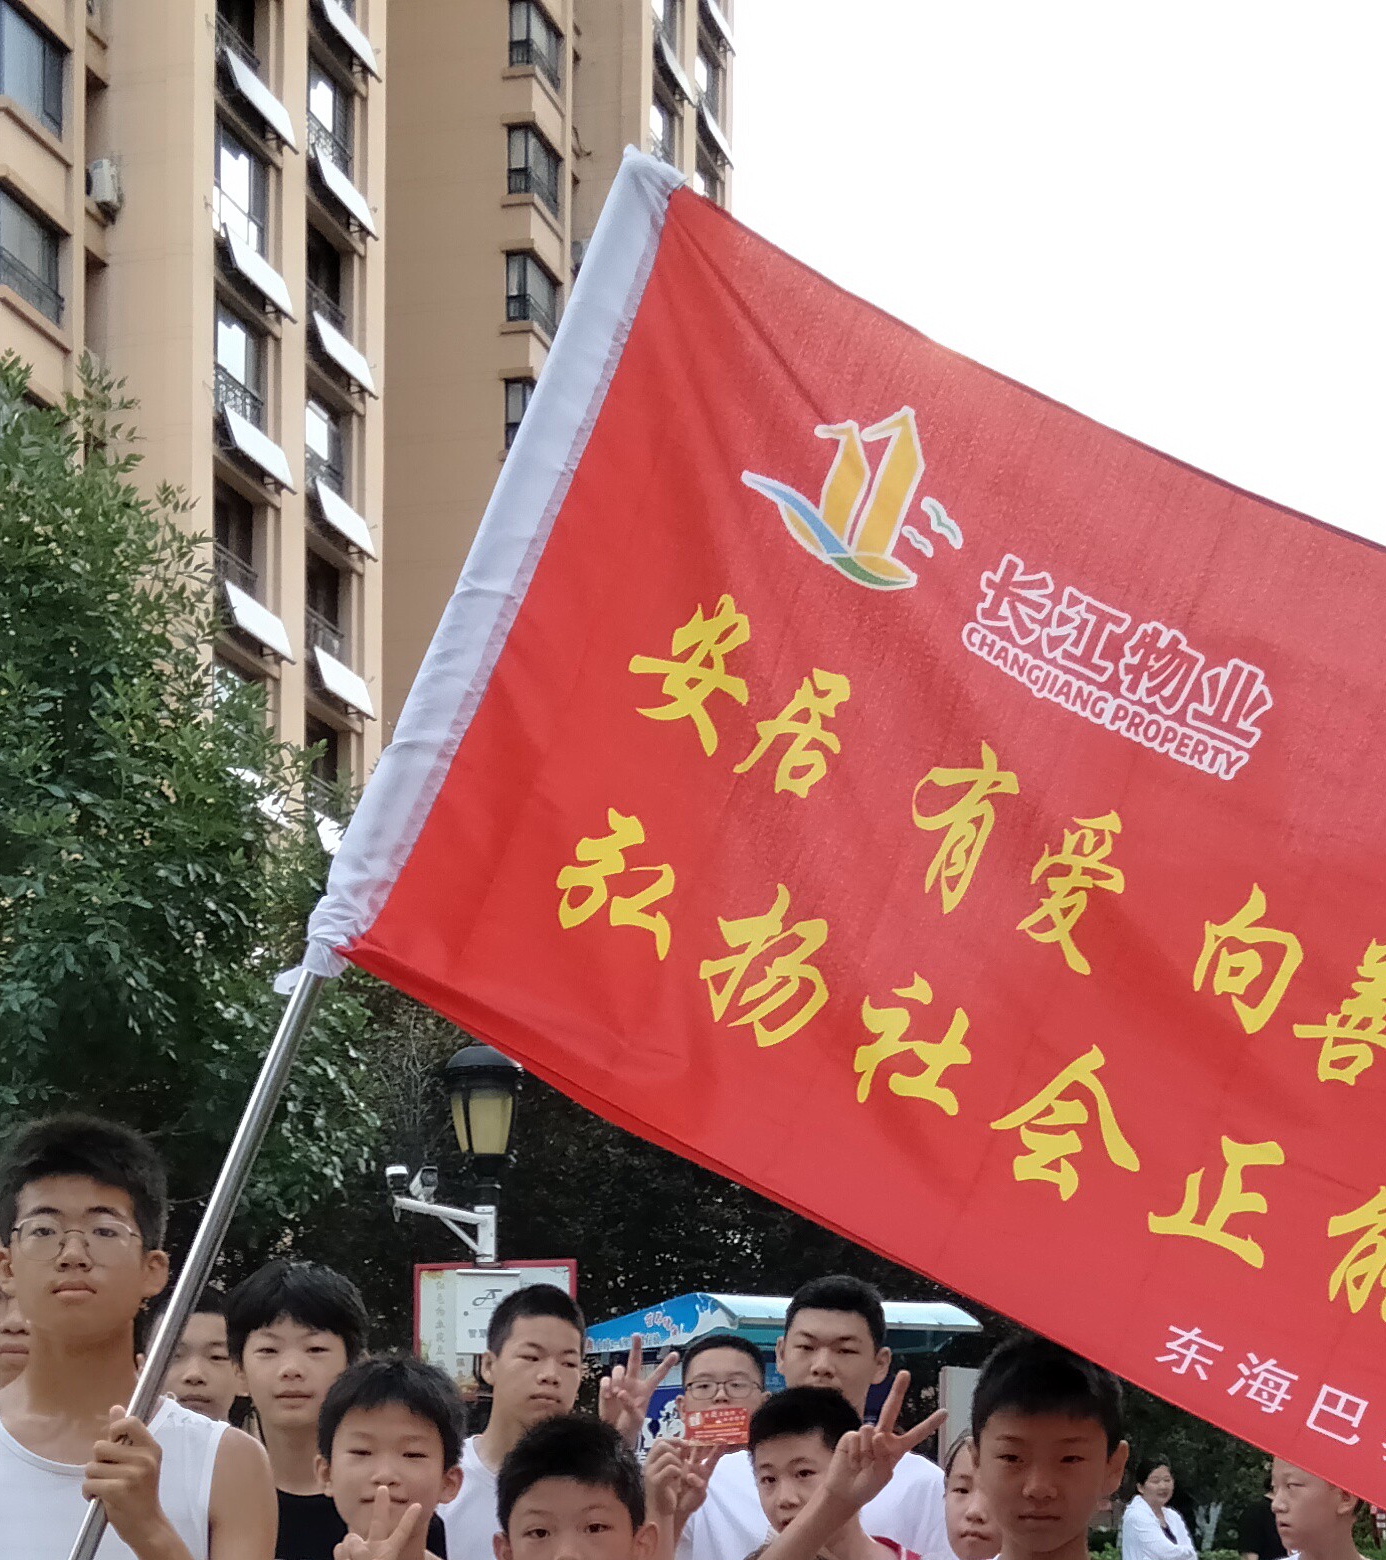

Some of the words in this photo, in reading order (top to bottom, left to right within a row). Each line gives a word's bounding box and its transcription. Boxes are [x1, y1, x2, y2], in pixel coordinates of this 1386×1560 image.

[961, 620, 1113, 728] CHANGJIANG
[1107, 695, 1251, 781] PROPERTY
[977, 552, 1275, 749] 长江物业
[627, 592, 852, 799] 安居
[911, 739, 1127, 975] 有爱
